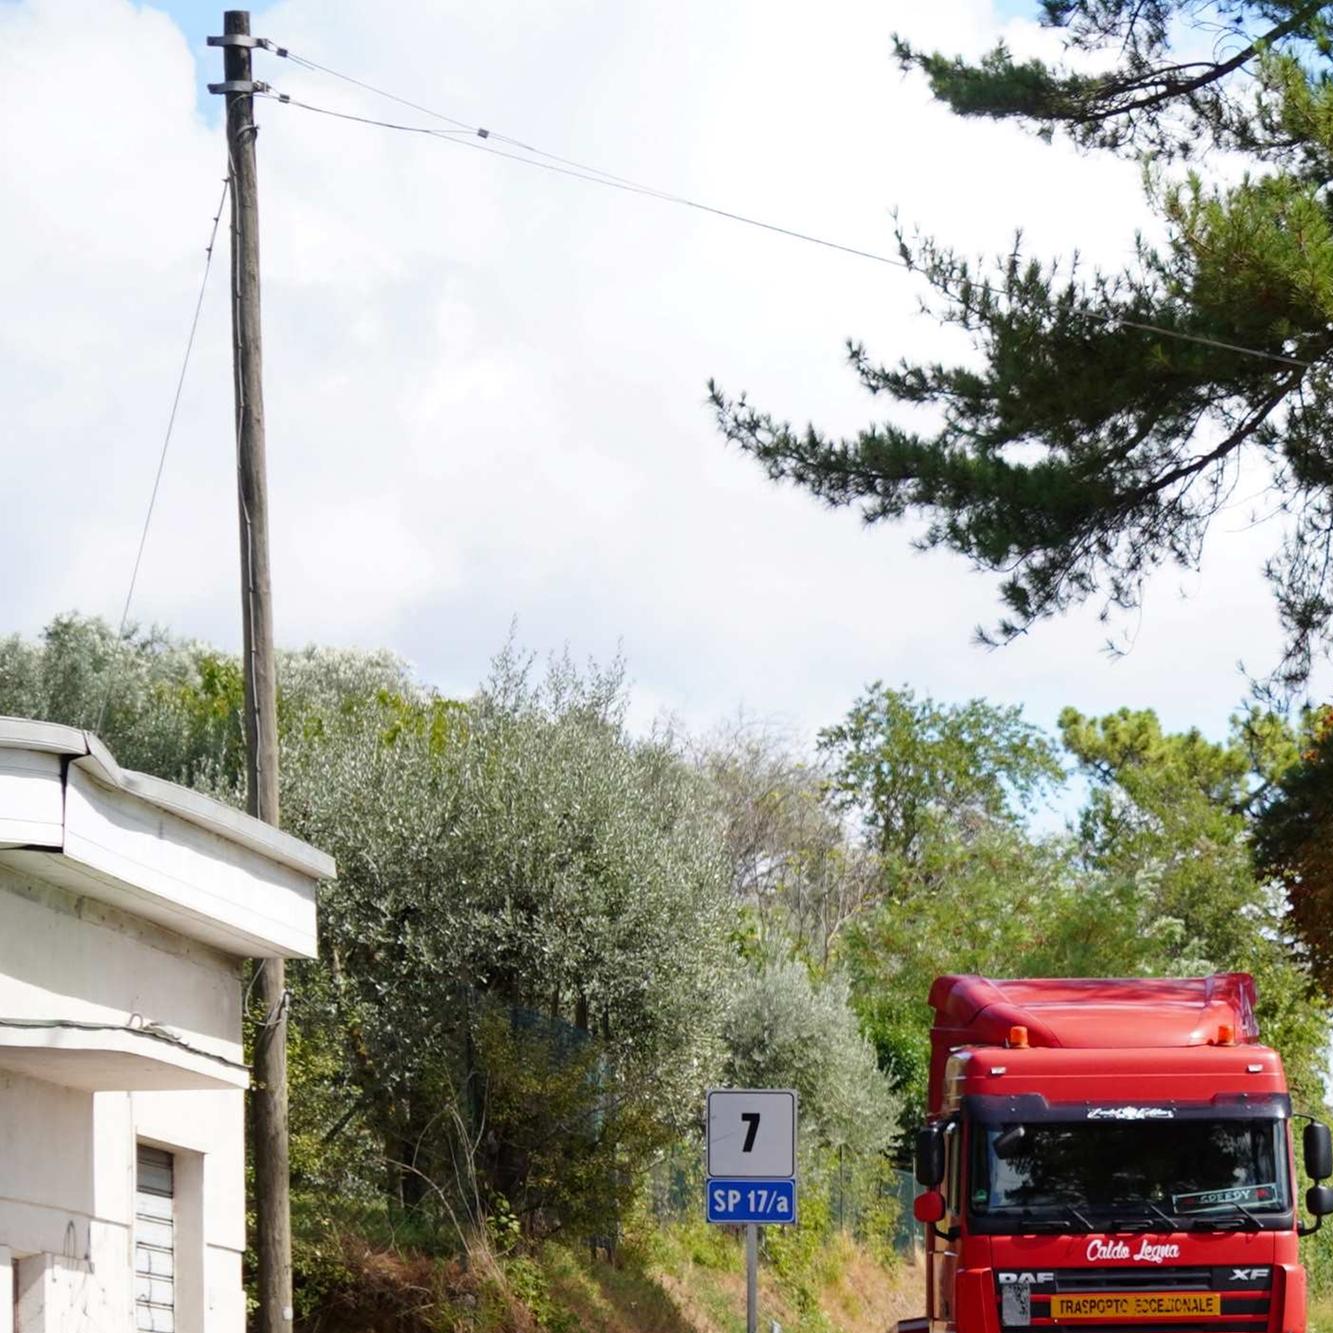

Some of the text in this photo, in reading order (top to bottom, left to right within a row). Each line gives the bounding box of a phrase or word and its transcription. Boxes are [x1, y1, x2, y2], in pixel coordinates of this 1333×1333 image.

[741, 1113, 760, 1153] 7
[713, 1190, 789, 1214] SP 17/a
[1087, 1239, 1180, 1264] Caldo Legna
[998, 1272, 1054, 1284] DAF
[1228, 1268, 1270, 1281] XF
